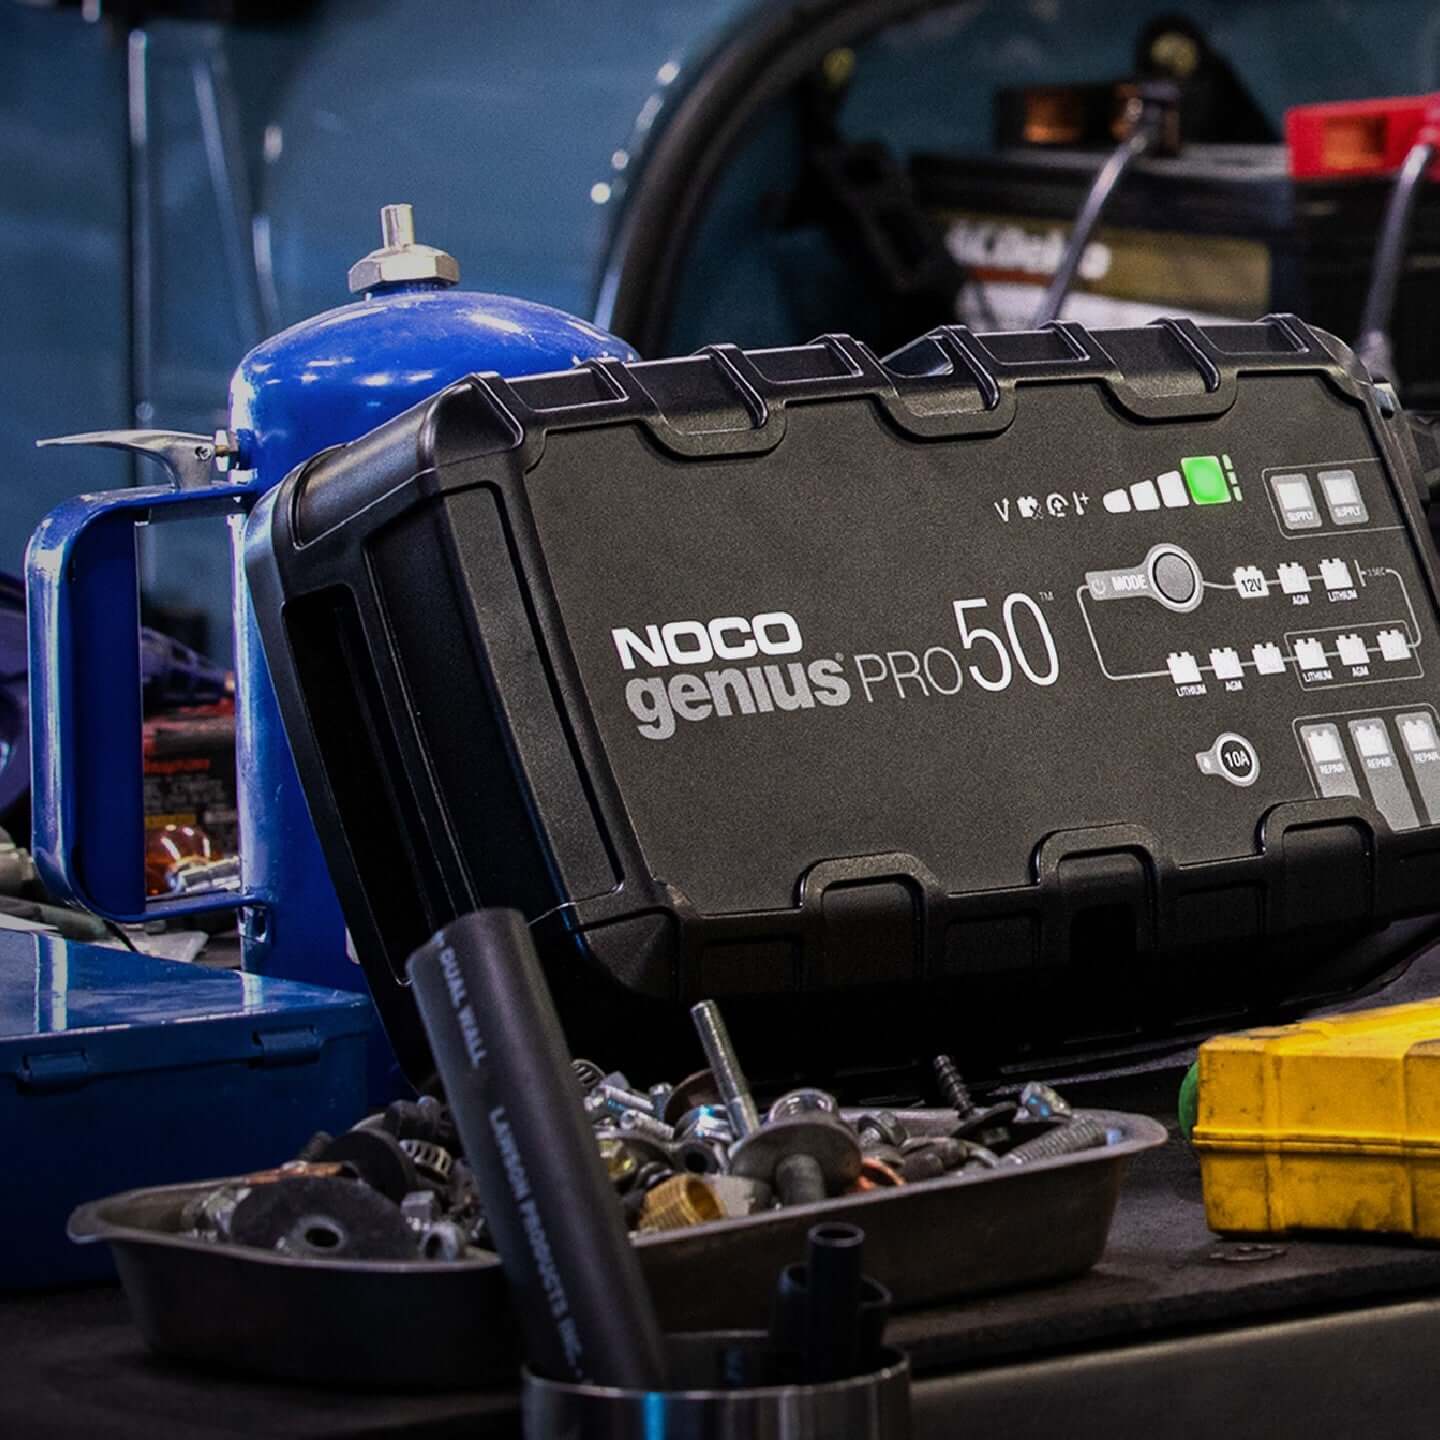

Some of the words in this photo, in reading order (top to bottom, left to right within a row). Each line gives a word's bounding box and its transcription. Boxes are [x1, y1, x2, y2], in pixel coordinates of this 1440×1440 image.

[1112, 574, 1148, 592] MODE
[1241, 579, 1262, 593] 12V
[1292, 594, 1310, 605] AGM
[1328, 590, 1358, 602] LITHIUM
[611, 611, 803, 670] NOCO
[625, 658, 851, 740] genius
[853, 646, 964, 702] PRO
[953, 592, 1060, 692] 50
[1302, 670, 1333, 683] LITHIUM
[1352, 665, 1369, 677] AGM
[1176, 684, 1207, 697] LITHIUM
[1225, 680, 1243, 692] AGM
[1225, 750, 1250, 768] 10A
[1367, 756, 1393, 768] REPAIR
[1414, 751, 1440, 763] REPAIR
[1319, 762, 1345, 774] REPAIR
[440, 944, 467, 1008] DUAL
[457, 1005, 487, 1069] WALL
